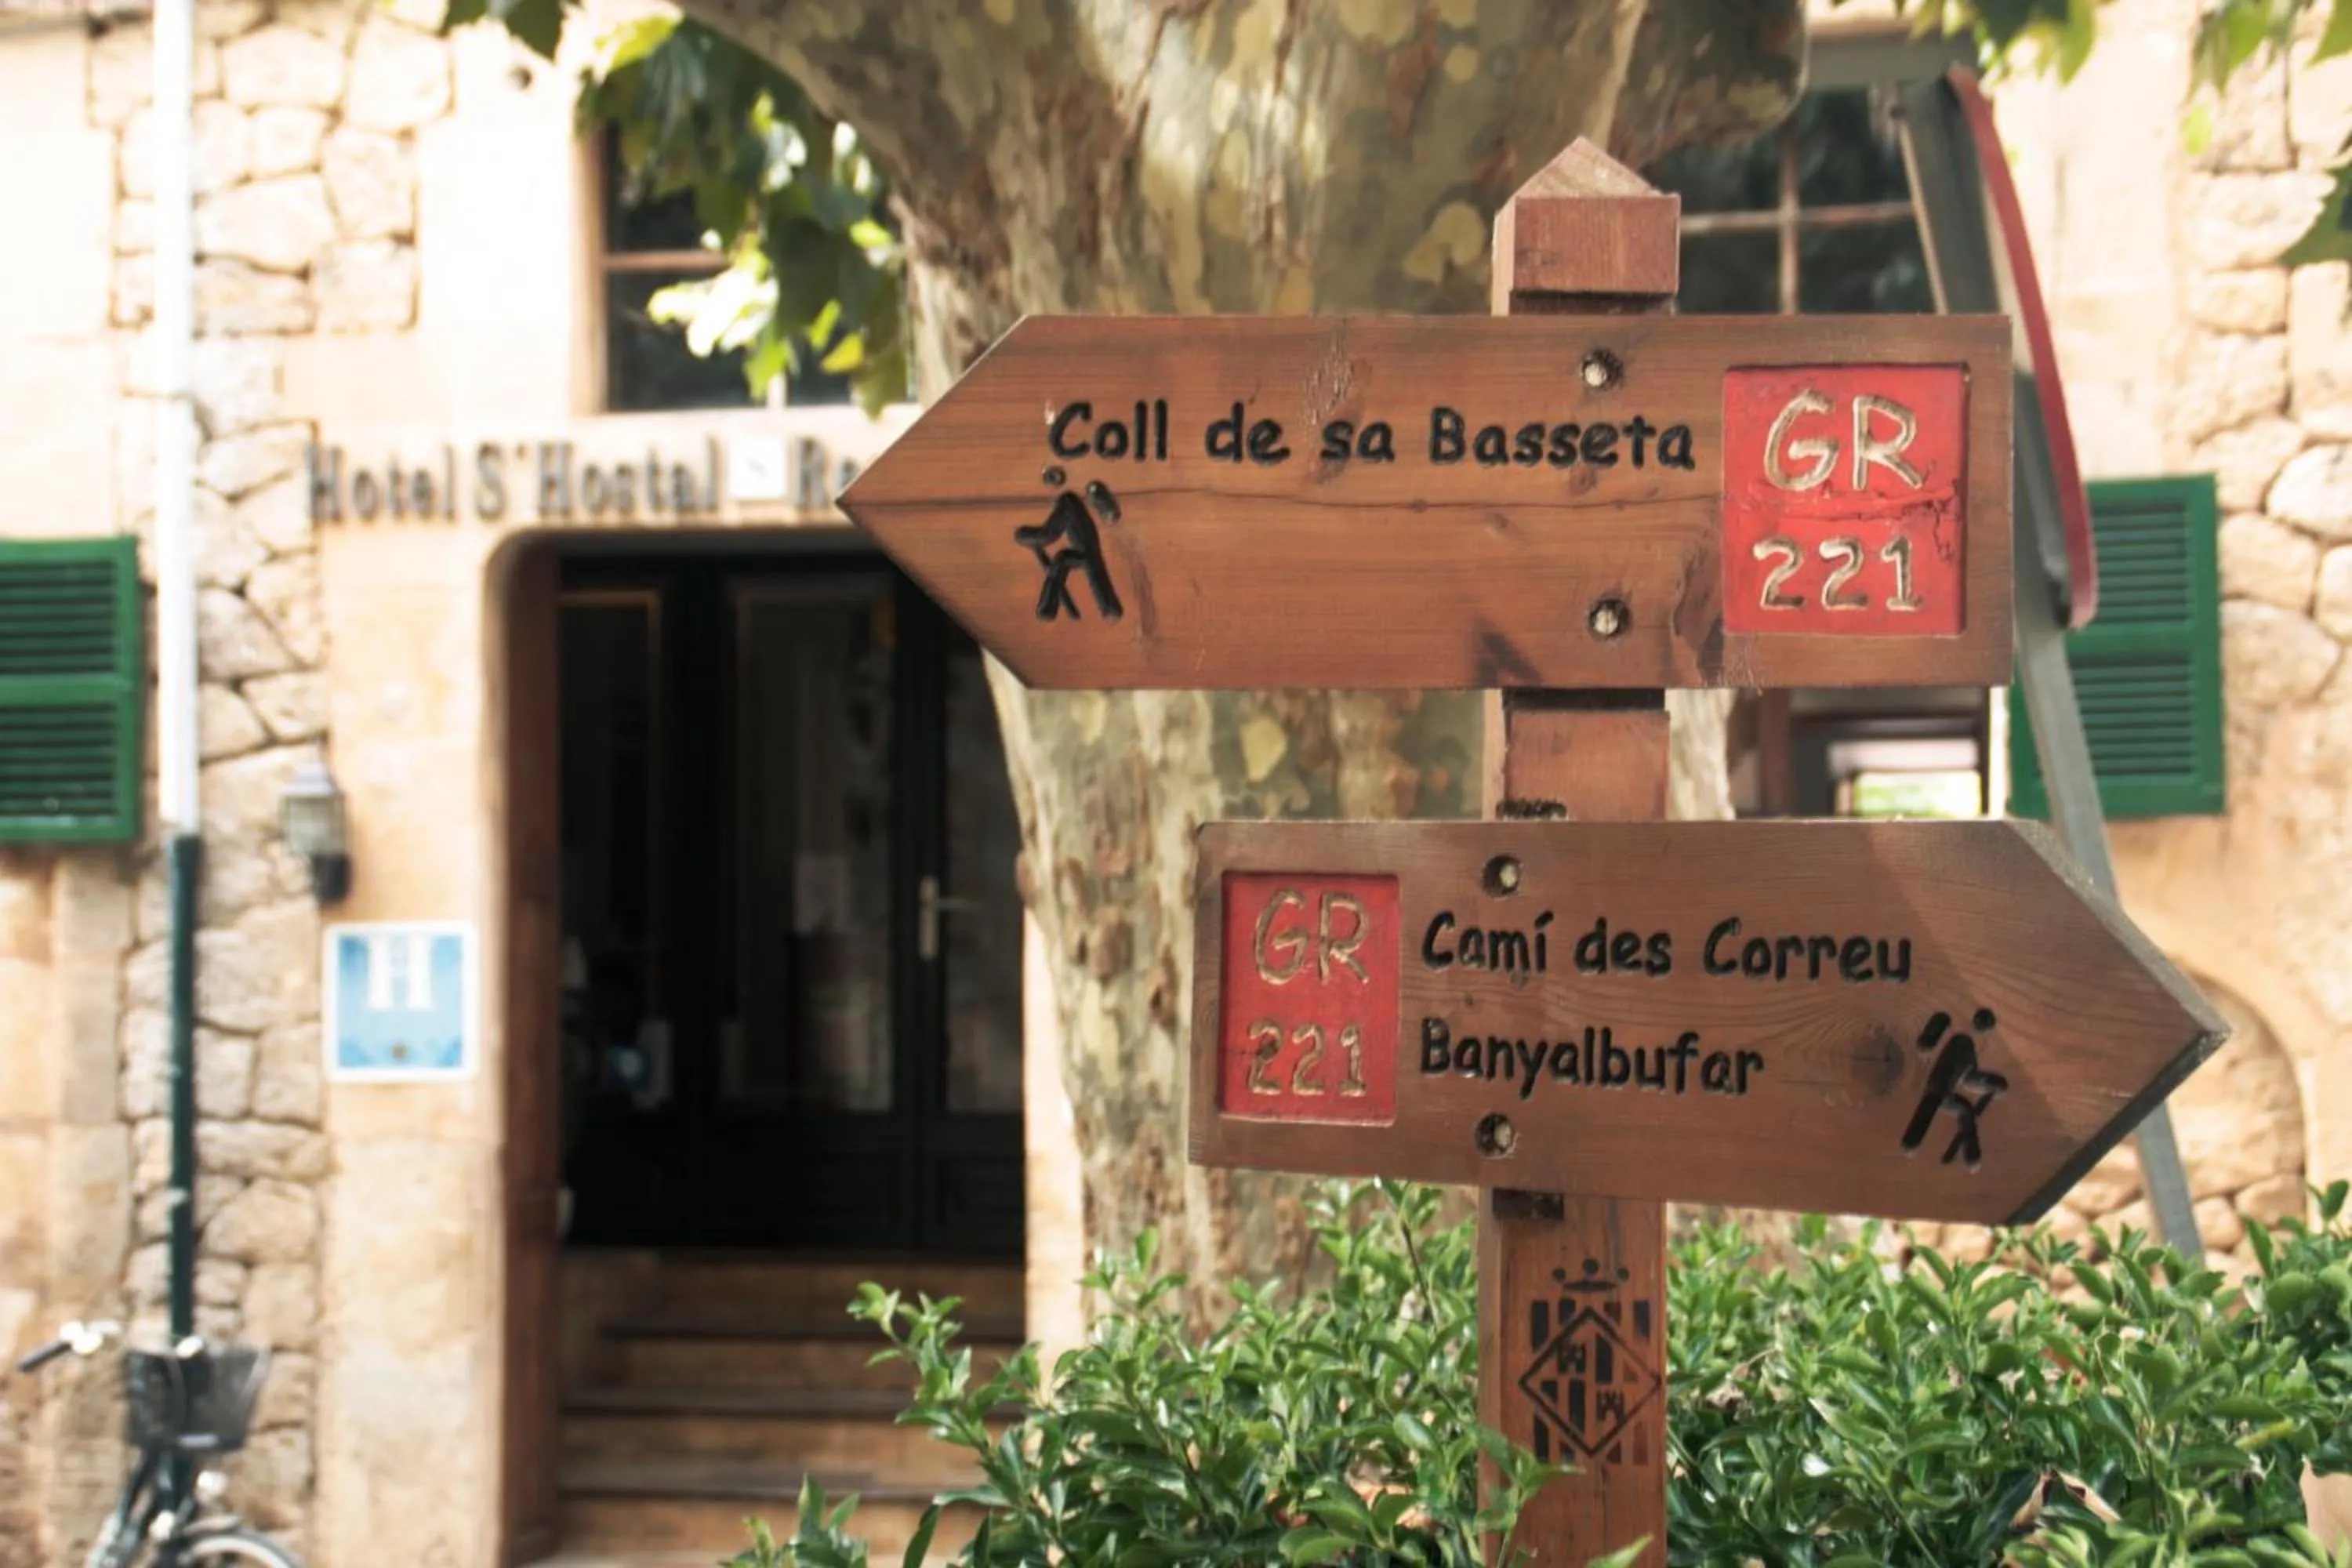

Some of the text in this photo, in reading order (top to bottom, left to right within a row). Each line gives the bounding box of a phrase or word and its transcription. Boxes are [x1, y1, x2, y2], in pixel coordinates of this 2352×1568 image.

[1049, 398, 1697, 471] Coll de sa Basseta
[1763, 388, 1923, 492] GR
[305, 439, 455, 523] Hotel
[1753, 534, 1923, 612] 221
[365, 933, 433, 1012] H
[1253, 887, 1370, 985] GR
[1421, 909, 1911, 983] Camí des Correu
[1247, 1022, 1367, 1097] 221
[1419, 1016, 1765, 1101] Banyalbufar
